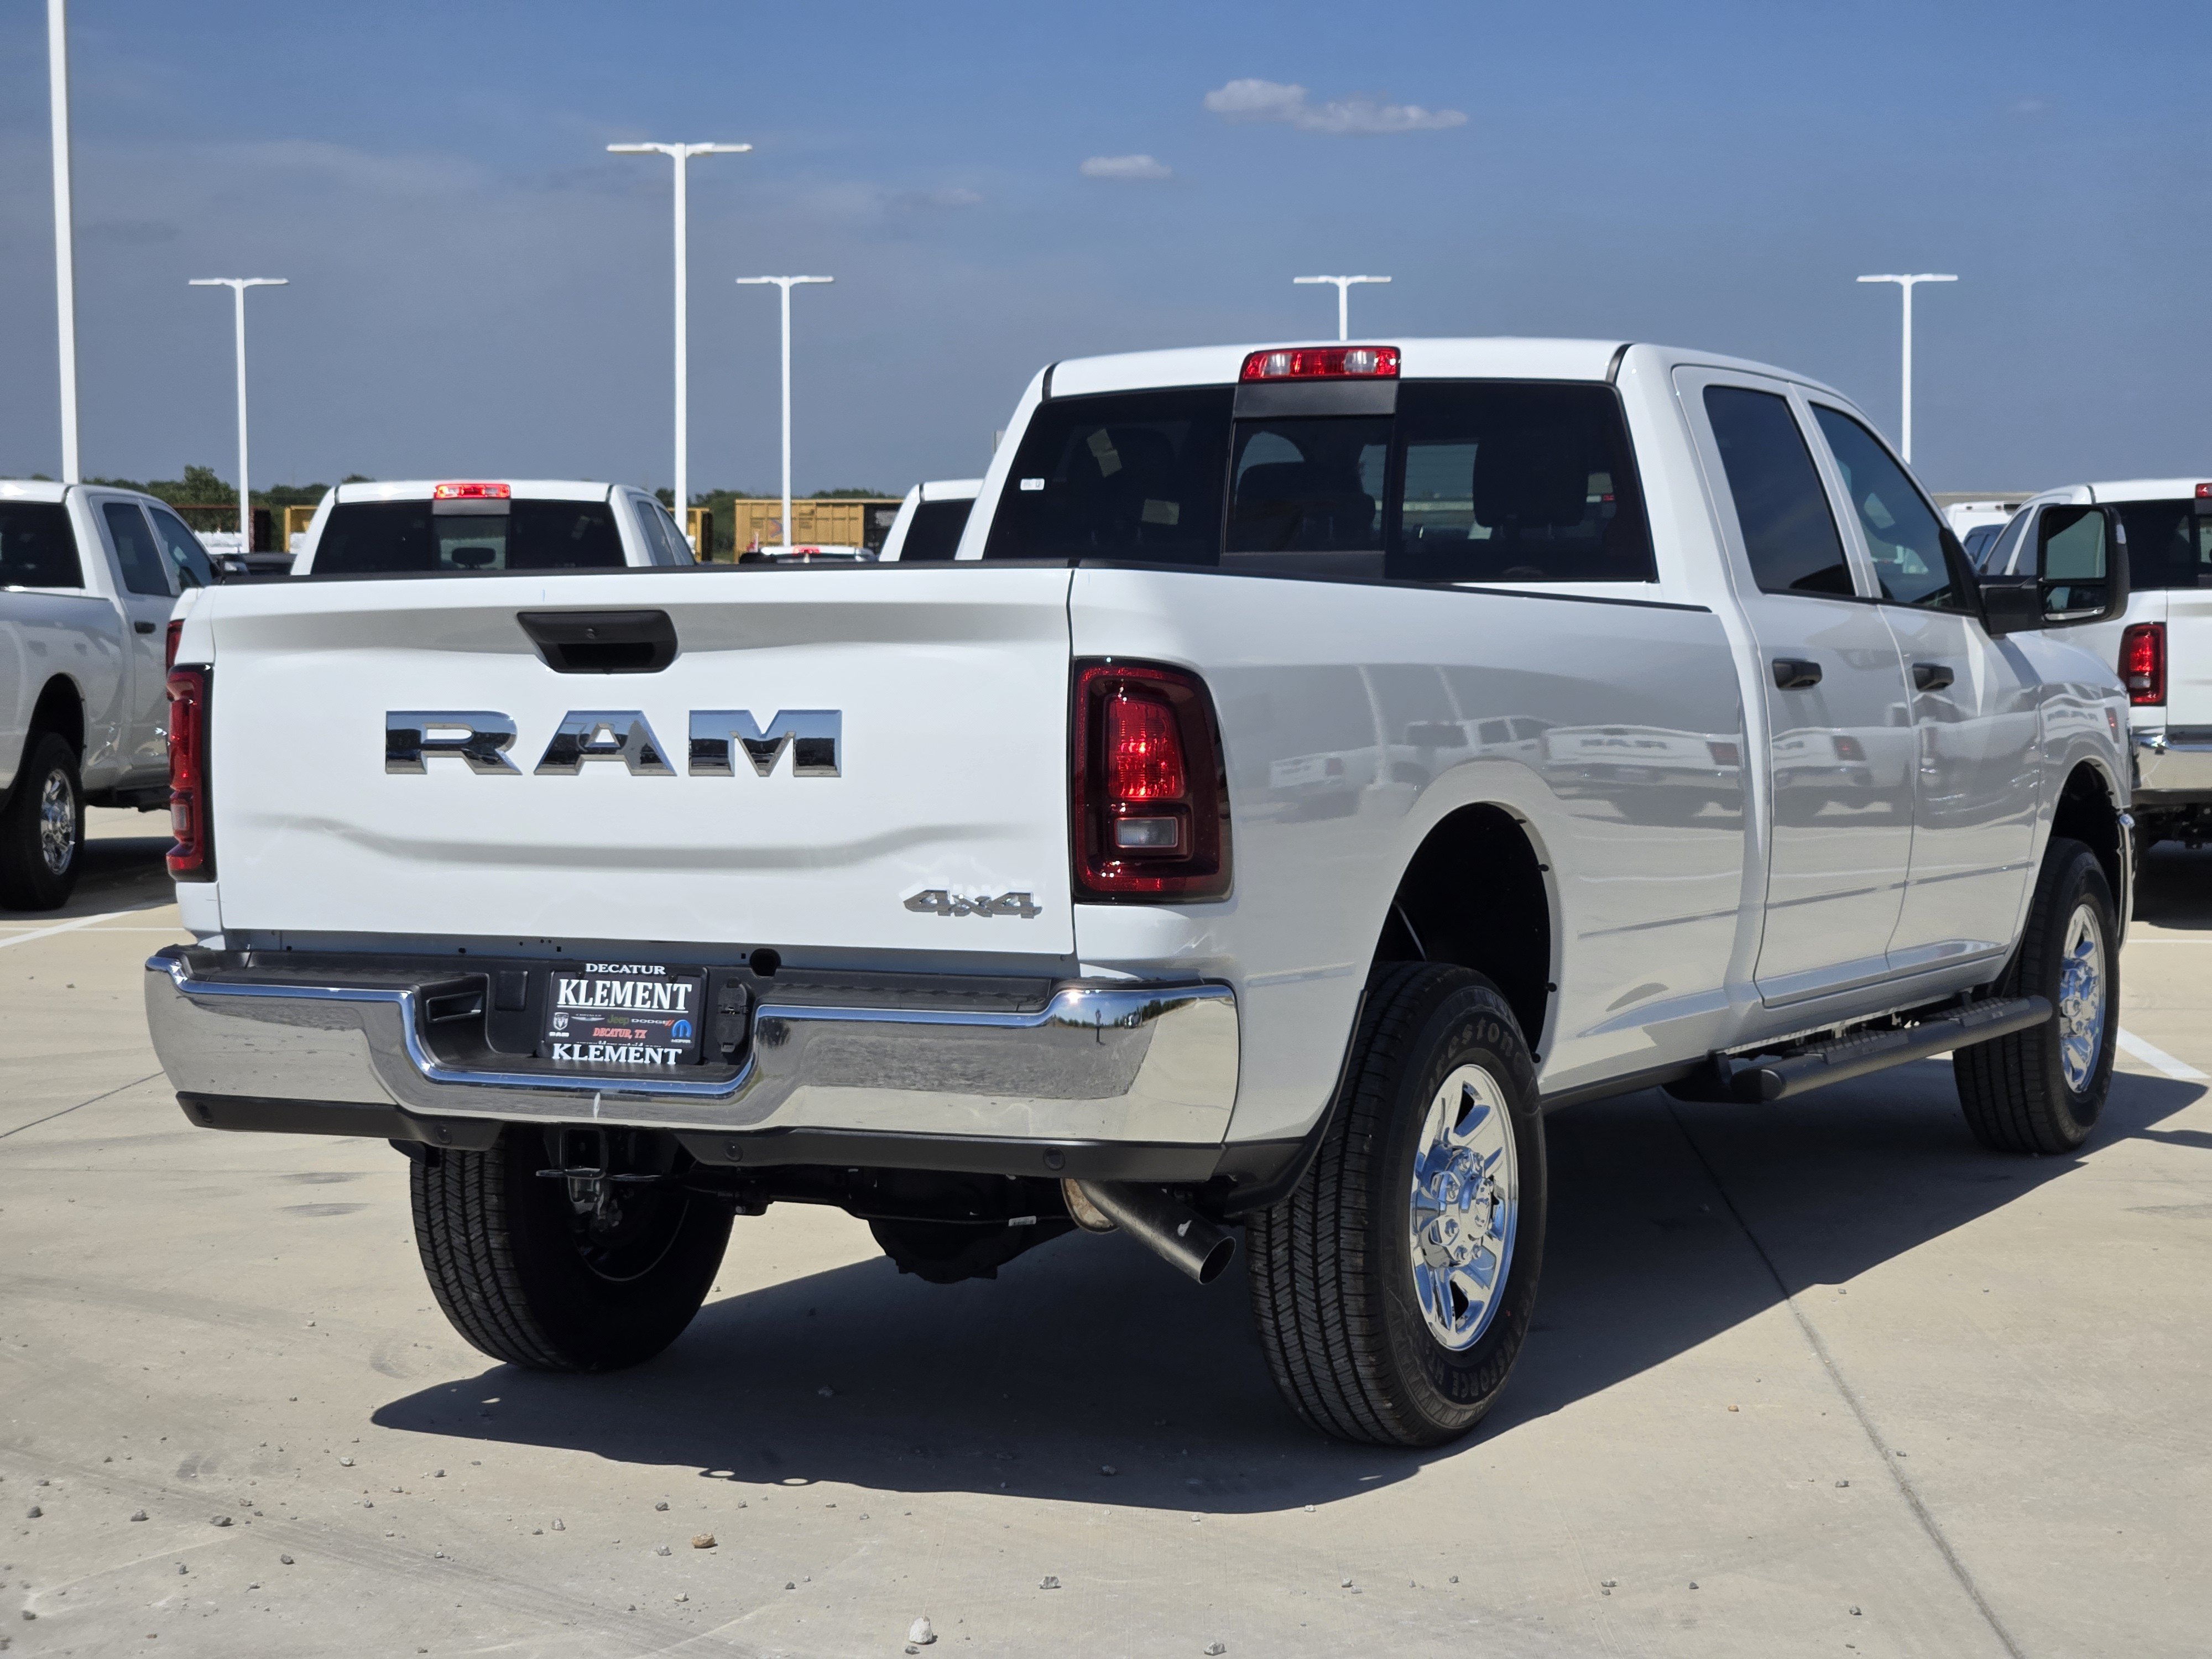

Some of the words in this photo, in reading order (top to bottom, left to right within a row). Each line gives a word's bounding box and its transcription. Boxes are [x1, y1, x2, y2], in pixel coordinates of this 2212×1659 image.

[385, 709, 842, 778] RAM
[586, 963, 666, 975] DECATUR
[557, 978, 692, 1010] KLEMENT
[607, 1014, 630, 1026] Jeep
[634, 1029, 648, 1039] TX
[552, 1043, 682, 1065] KLEMENT
